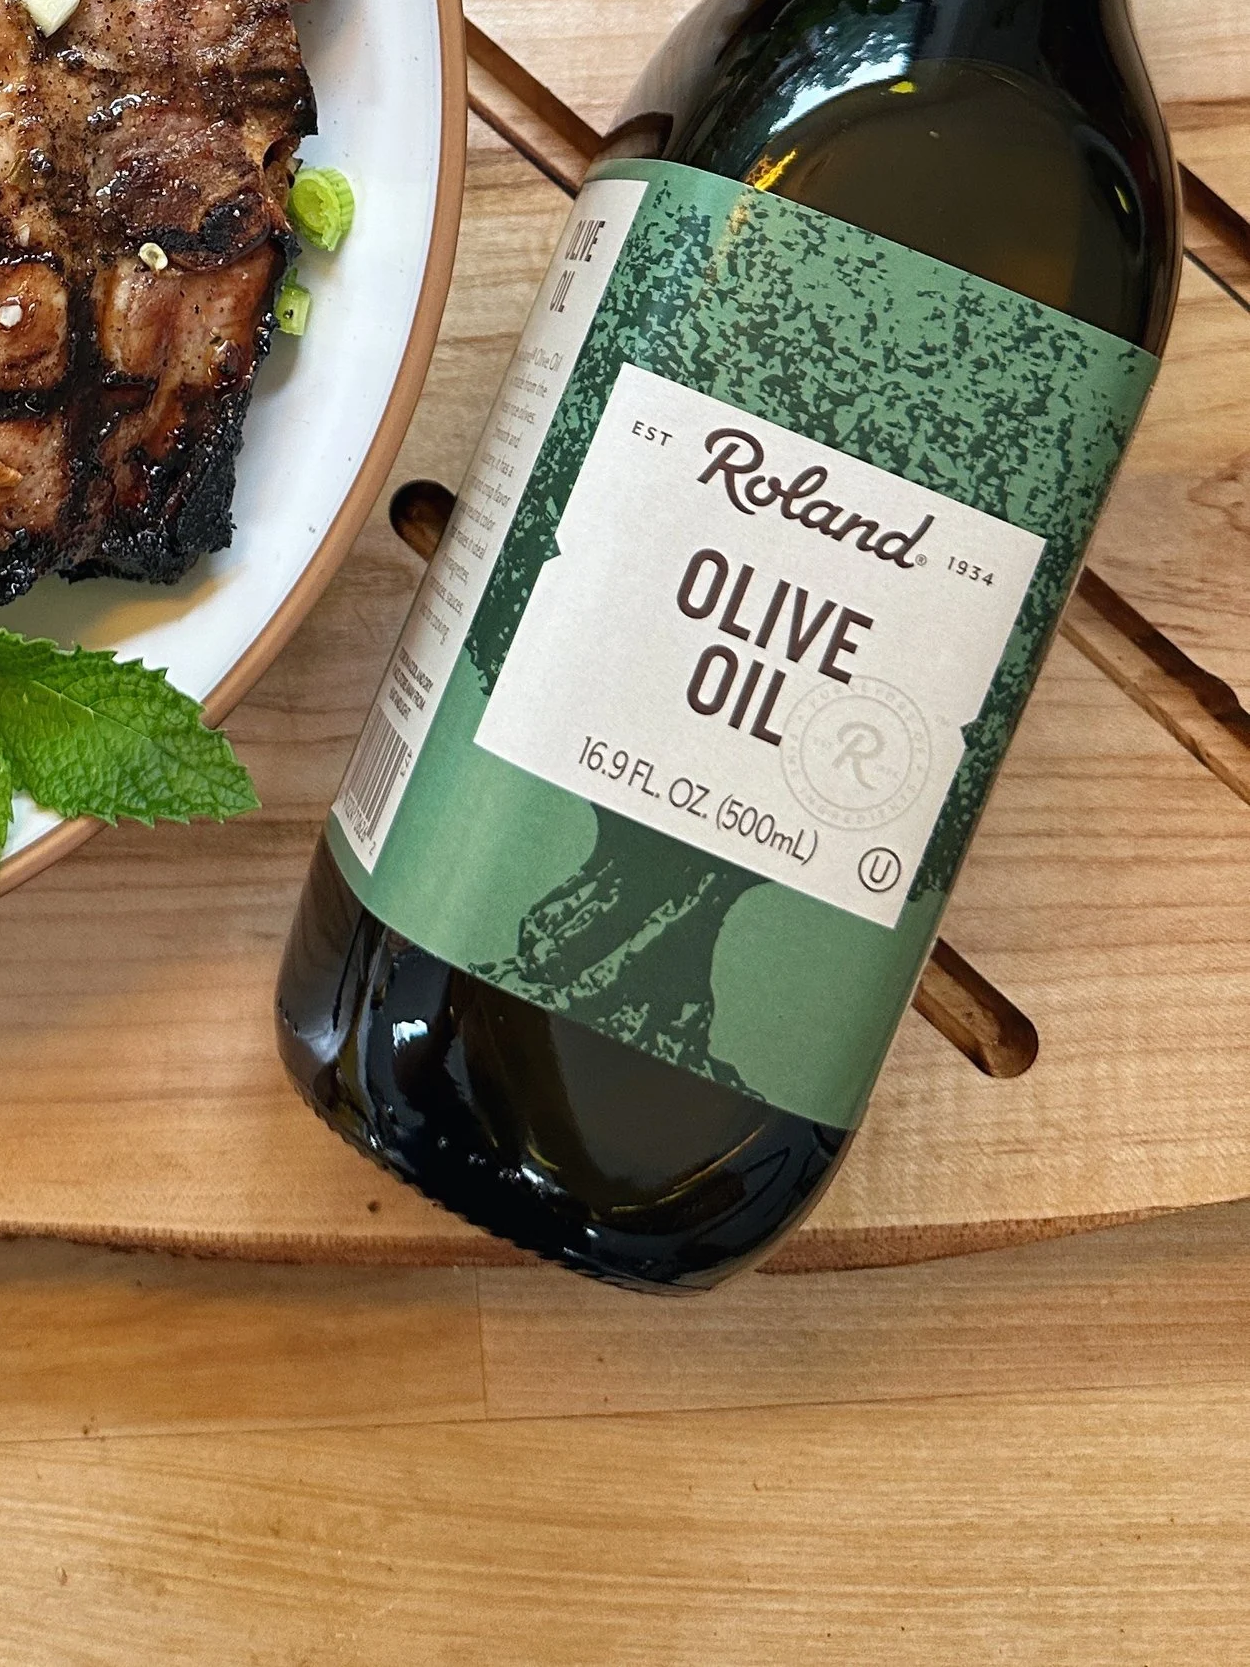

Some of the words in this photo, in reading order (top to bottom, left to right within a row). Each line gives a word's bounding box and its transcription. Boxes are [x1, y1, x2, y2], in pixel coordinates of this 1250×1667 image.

[549, 269, 576, 313] OIL
[564, 219, 606, 263] OLIVE
[631, 420, 673, 446] EST
[947, 555, 995, 587] 1934
[676, 548, 874, 686] OLIVE
[686, 644, 786, 747] OIL
[577, 735, 629, 781] 16.9
[627, 757, 661, 800] FL.
[668, 776, 711, 820] OZ.
[715, 794, 819, 867] (500mL)
